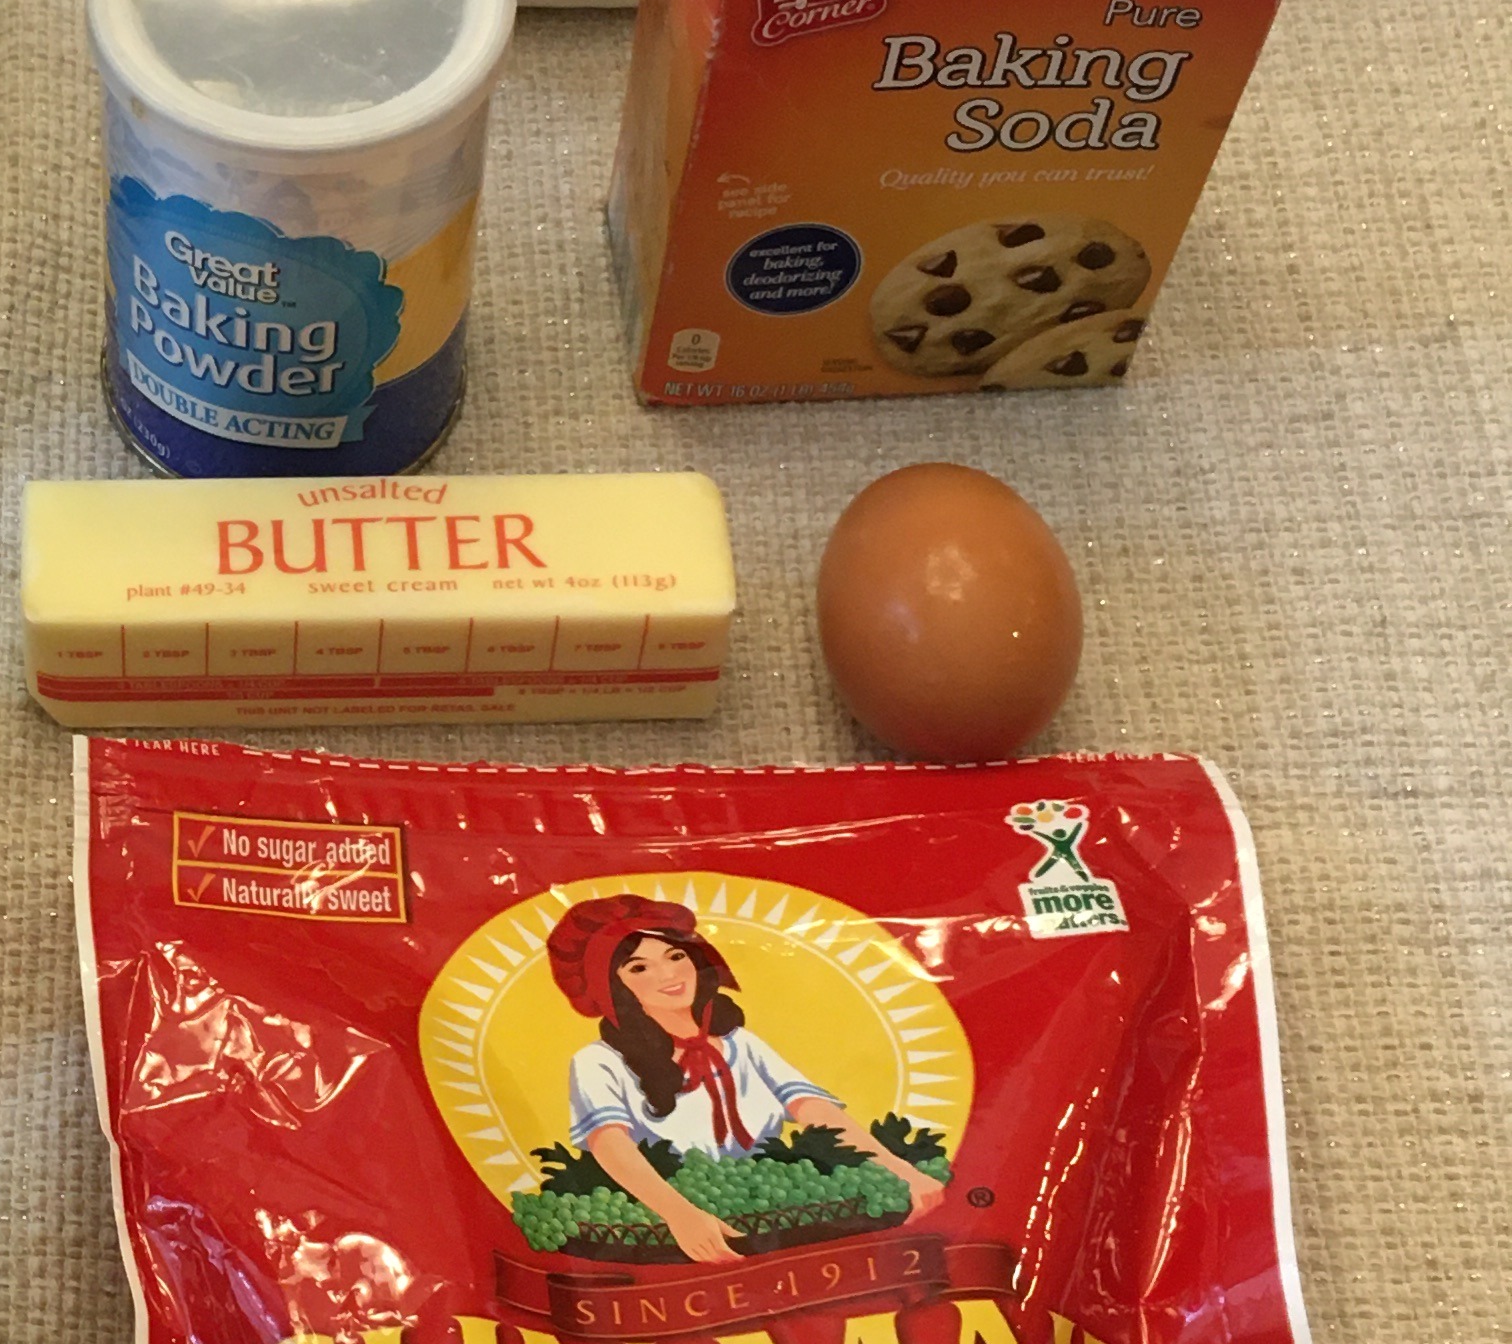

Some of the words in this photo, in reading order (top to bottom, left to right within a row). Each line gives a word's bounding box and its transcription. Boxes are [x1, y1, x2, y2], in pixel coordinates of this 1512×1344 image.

[871, 31, 1193, 102] Baking
[944, 96, 1162, 152] Soda
[879, 167, 974, 191] Quality
[979, 171, 1029, 189] you
[1033, 167, 1078, 183] can
[1084, 164, 1156, 182] trust!
[164, 229, 281, 288] Great
[749, 243, 813, 258] excellent
[816, 241, 838, 252] for
[743, 269, 844, 287] deodorizing
[749, 286, 785, 301] and
[787, 283, 835, 299] more!
[132, 255, 339, 364] Baking
[129, 294, 346, 398] Powder
[136, 364, 220, 429] DOUBLE
[224, 416, 337, 442] ACTING
[664, 381, 694, 397] NET
[696, 383, 725, 397] WT
[730, 383, 746, 397] 16
[749, 383, 769, 397] OZ
[297, 478, 448, 507] unsalted
[215, 513, 548, 576] BUTTER
[126, 583, 172, 602] plant
[179, 582, 246, 598] #49-34
[308, 579, 375, 594] sweet
[387, 578, 459, 593] cream
[492, 576, 524, 590] net
[531, 575, 555, 589] wt
[564, 575, 603, 590] 4oz
[611, 573, 678, 592] (113g)
[236, 707, 267, 716] THIS
[302, 706, 330, 715] NOT
[334, 705, 395, 715] LABELED
[399, 704, 427, 713] FOR
[179, 740, 220, 756] HERE
[222, 828, 250, 858] No
[257, 835, 317, 869] sugar
[326, 837, 390, 866] added
[328, 885, 392, 913] sweet
[1032, 893, 1115, 915] more
[575, 1285, 753, 1326] SINCE
[785, 1248, 924, 1298] 1912
